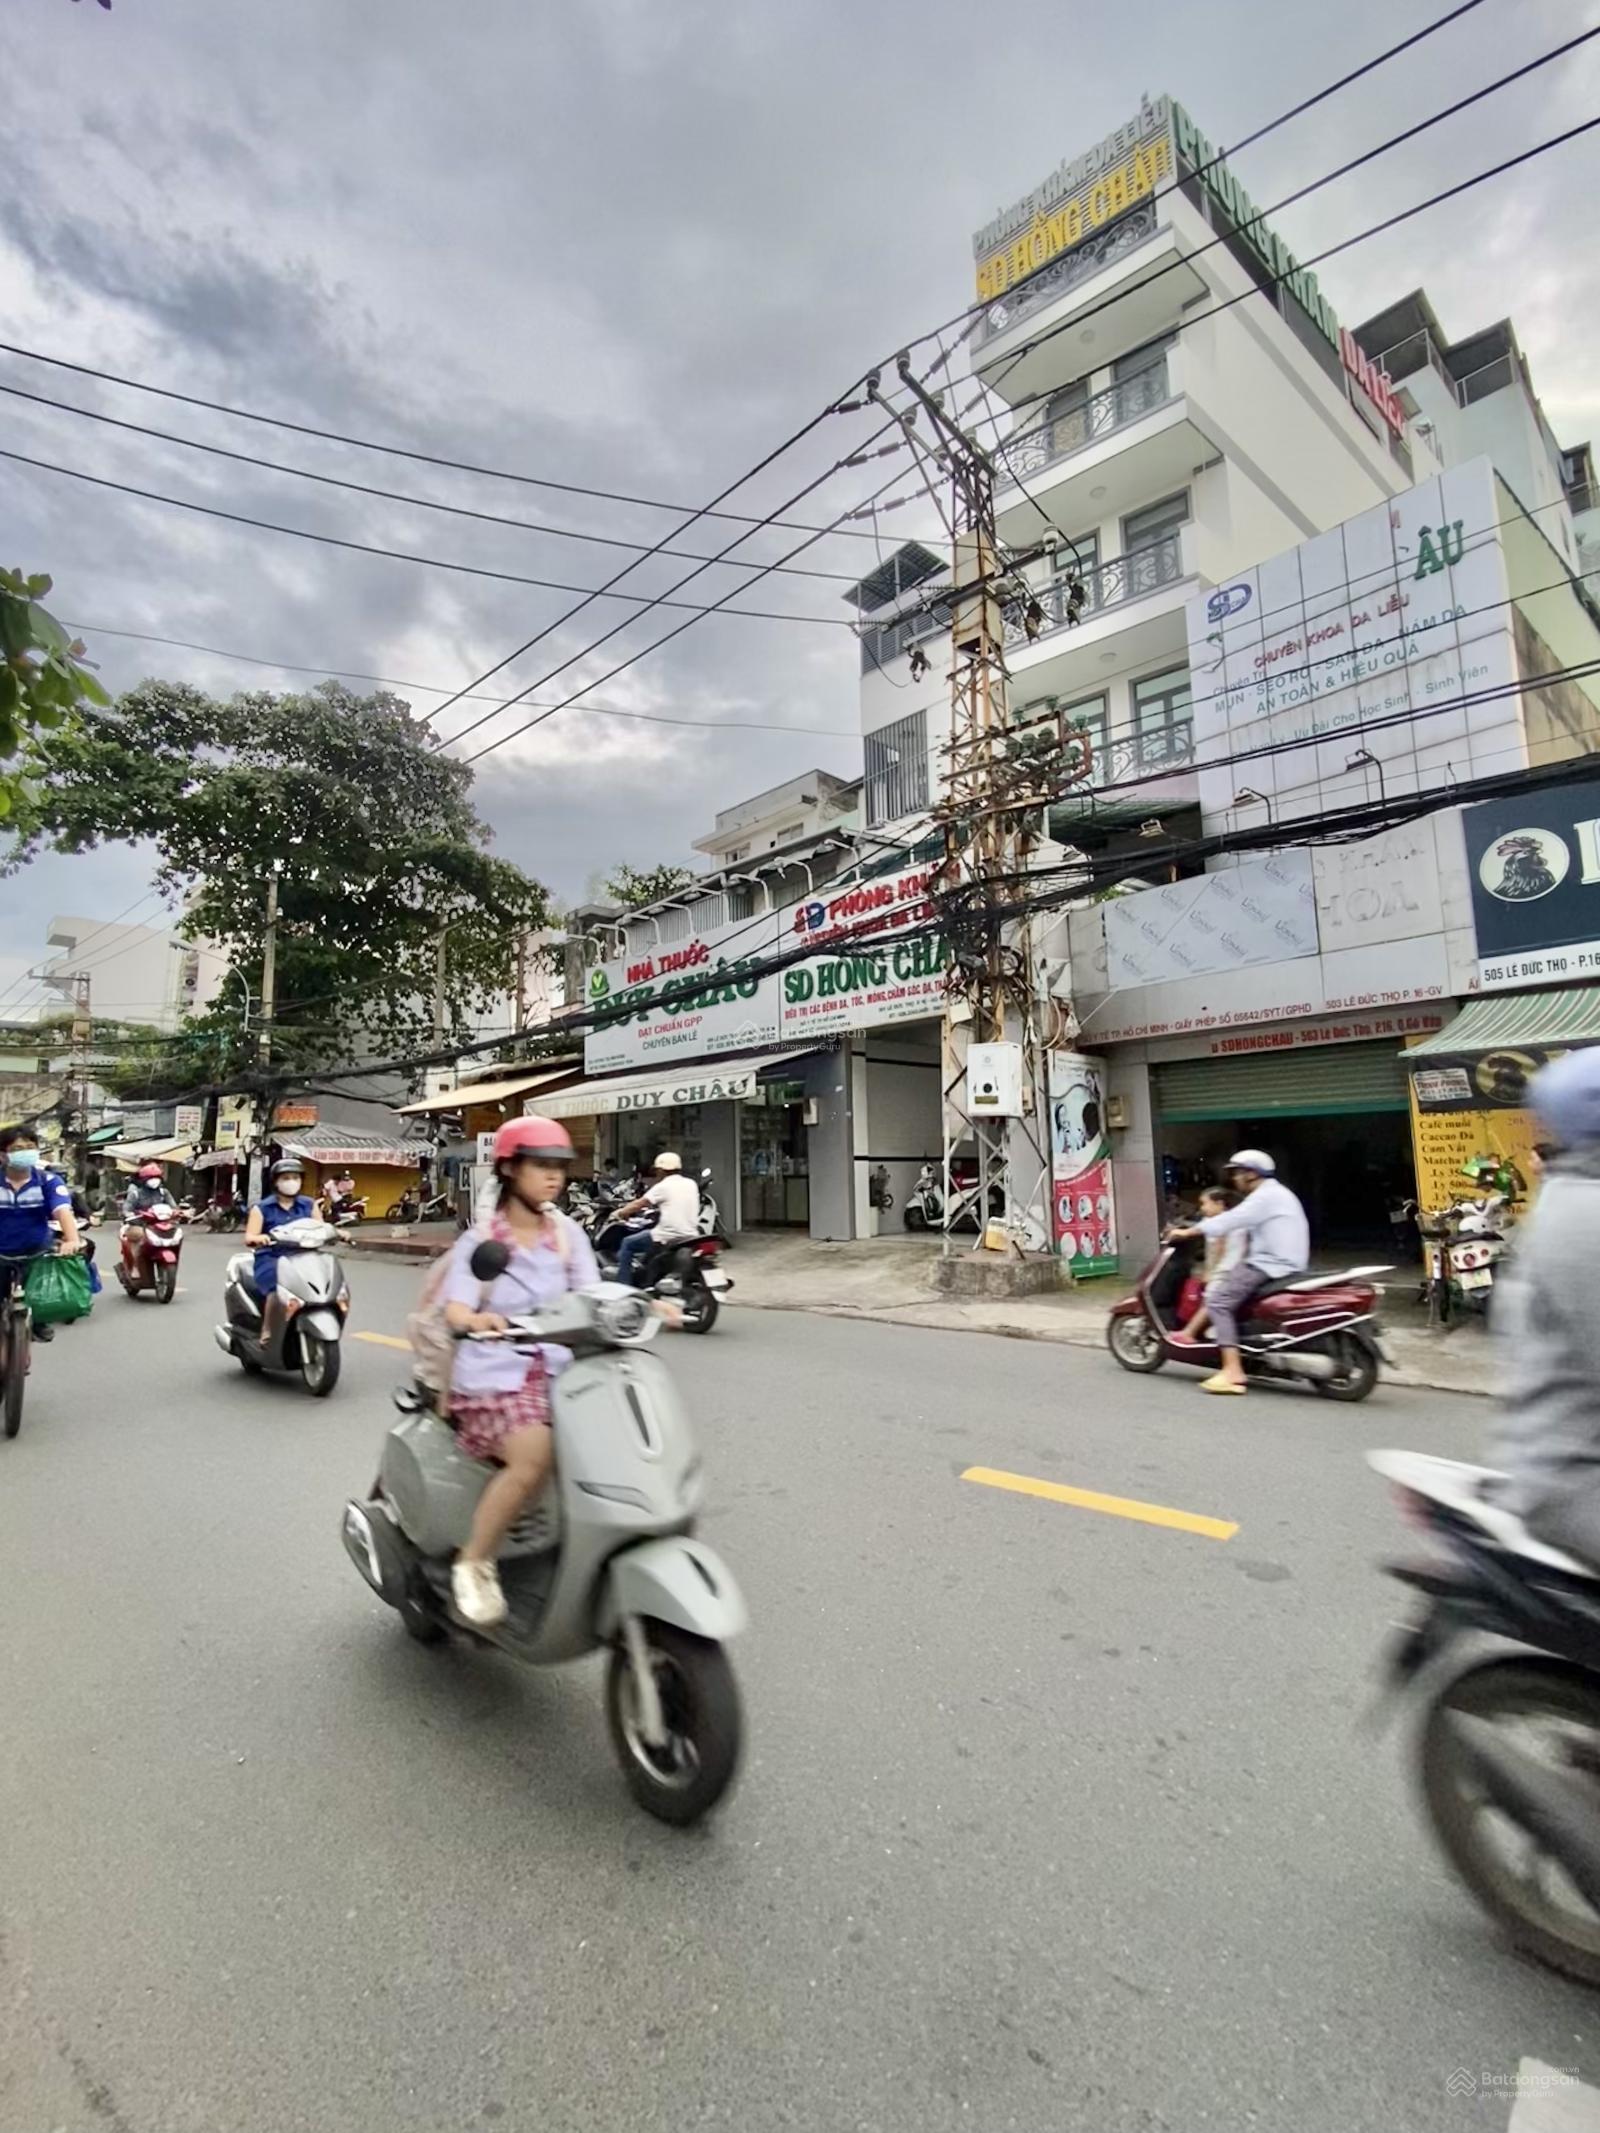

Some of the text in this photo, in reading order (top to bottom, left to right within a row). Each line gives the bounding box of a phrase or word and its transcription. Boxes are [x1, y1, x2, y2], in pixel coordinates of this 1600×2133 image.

[1009, 208, 1083, 286] HỒNG
[1414, 519, 1464, 580] ÂU
[1254, 593, 1410, 668] CHUYÊN KHOA DA LIỄU
[1441, 604, 1468, 622] DA
[1257, 699, 1276, 714] AN
[1280, 680, 1320, 704] TOÀN
[1325, 676, 1336, 689] &
[1333, 711, 1356, 726] Cho
[1359, 702, 1382, 719] Học
[1385, 691, 1411, 709] Sinh
[1425, 676, 1455, 695] Sinh
[1459, 665, 1489, 682] Viên
[829, 883, 895, 921] PHÒNG
[626, 939, 711, 984] NHÀ THUỐC
[1485, 967, 1504, 982] 505
[1507, 962, 1521, 978] LÊ
[1522, 960, 1544, 976] ĐỨC
[1547, 957, 1568, 974] THỌ
[784, 968, 814, 1004] SD
[1344, 995, 1357, 1008] LÊ
[1358, 992, 1378, 1006] ĐỨC
[684, 1015, 704, 1031] GPP
[809, 1001, 821, 1015] CÁC
[1219, 1011, 1231, 1025] SỐ
[616, 1091, 665, 1111] DUY
[672, 1076, 750, 1104] CHÂU
